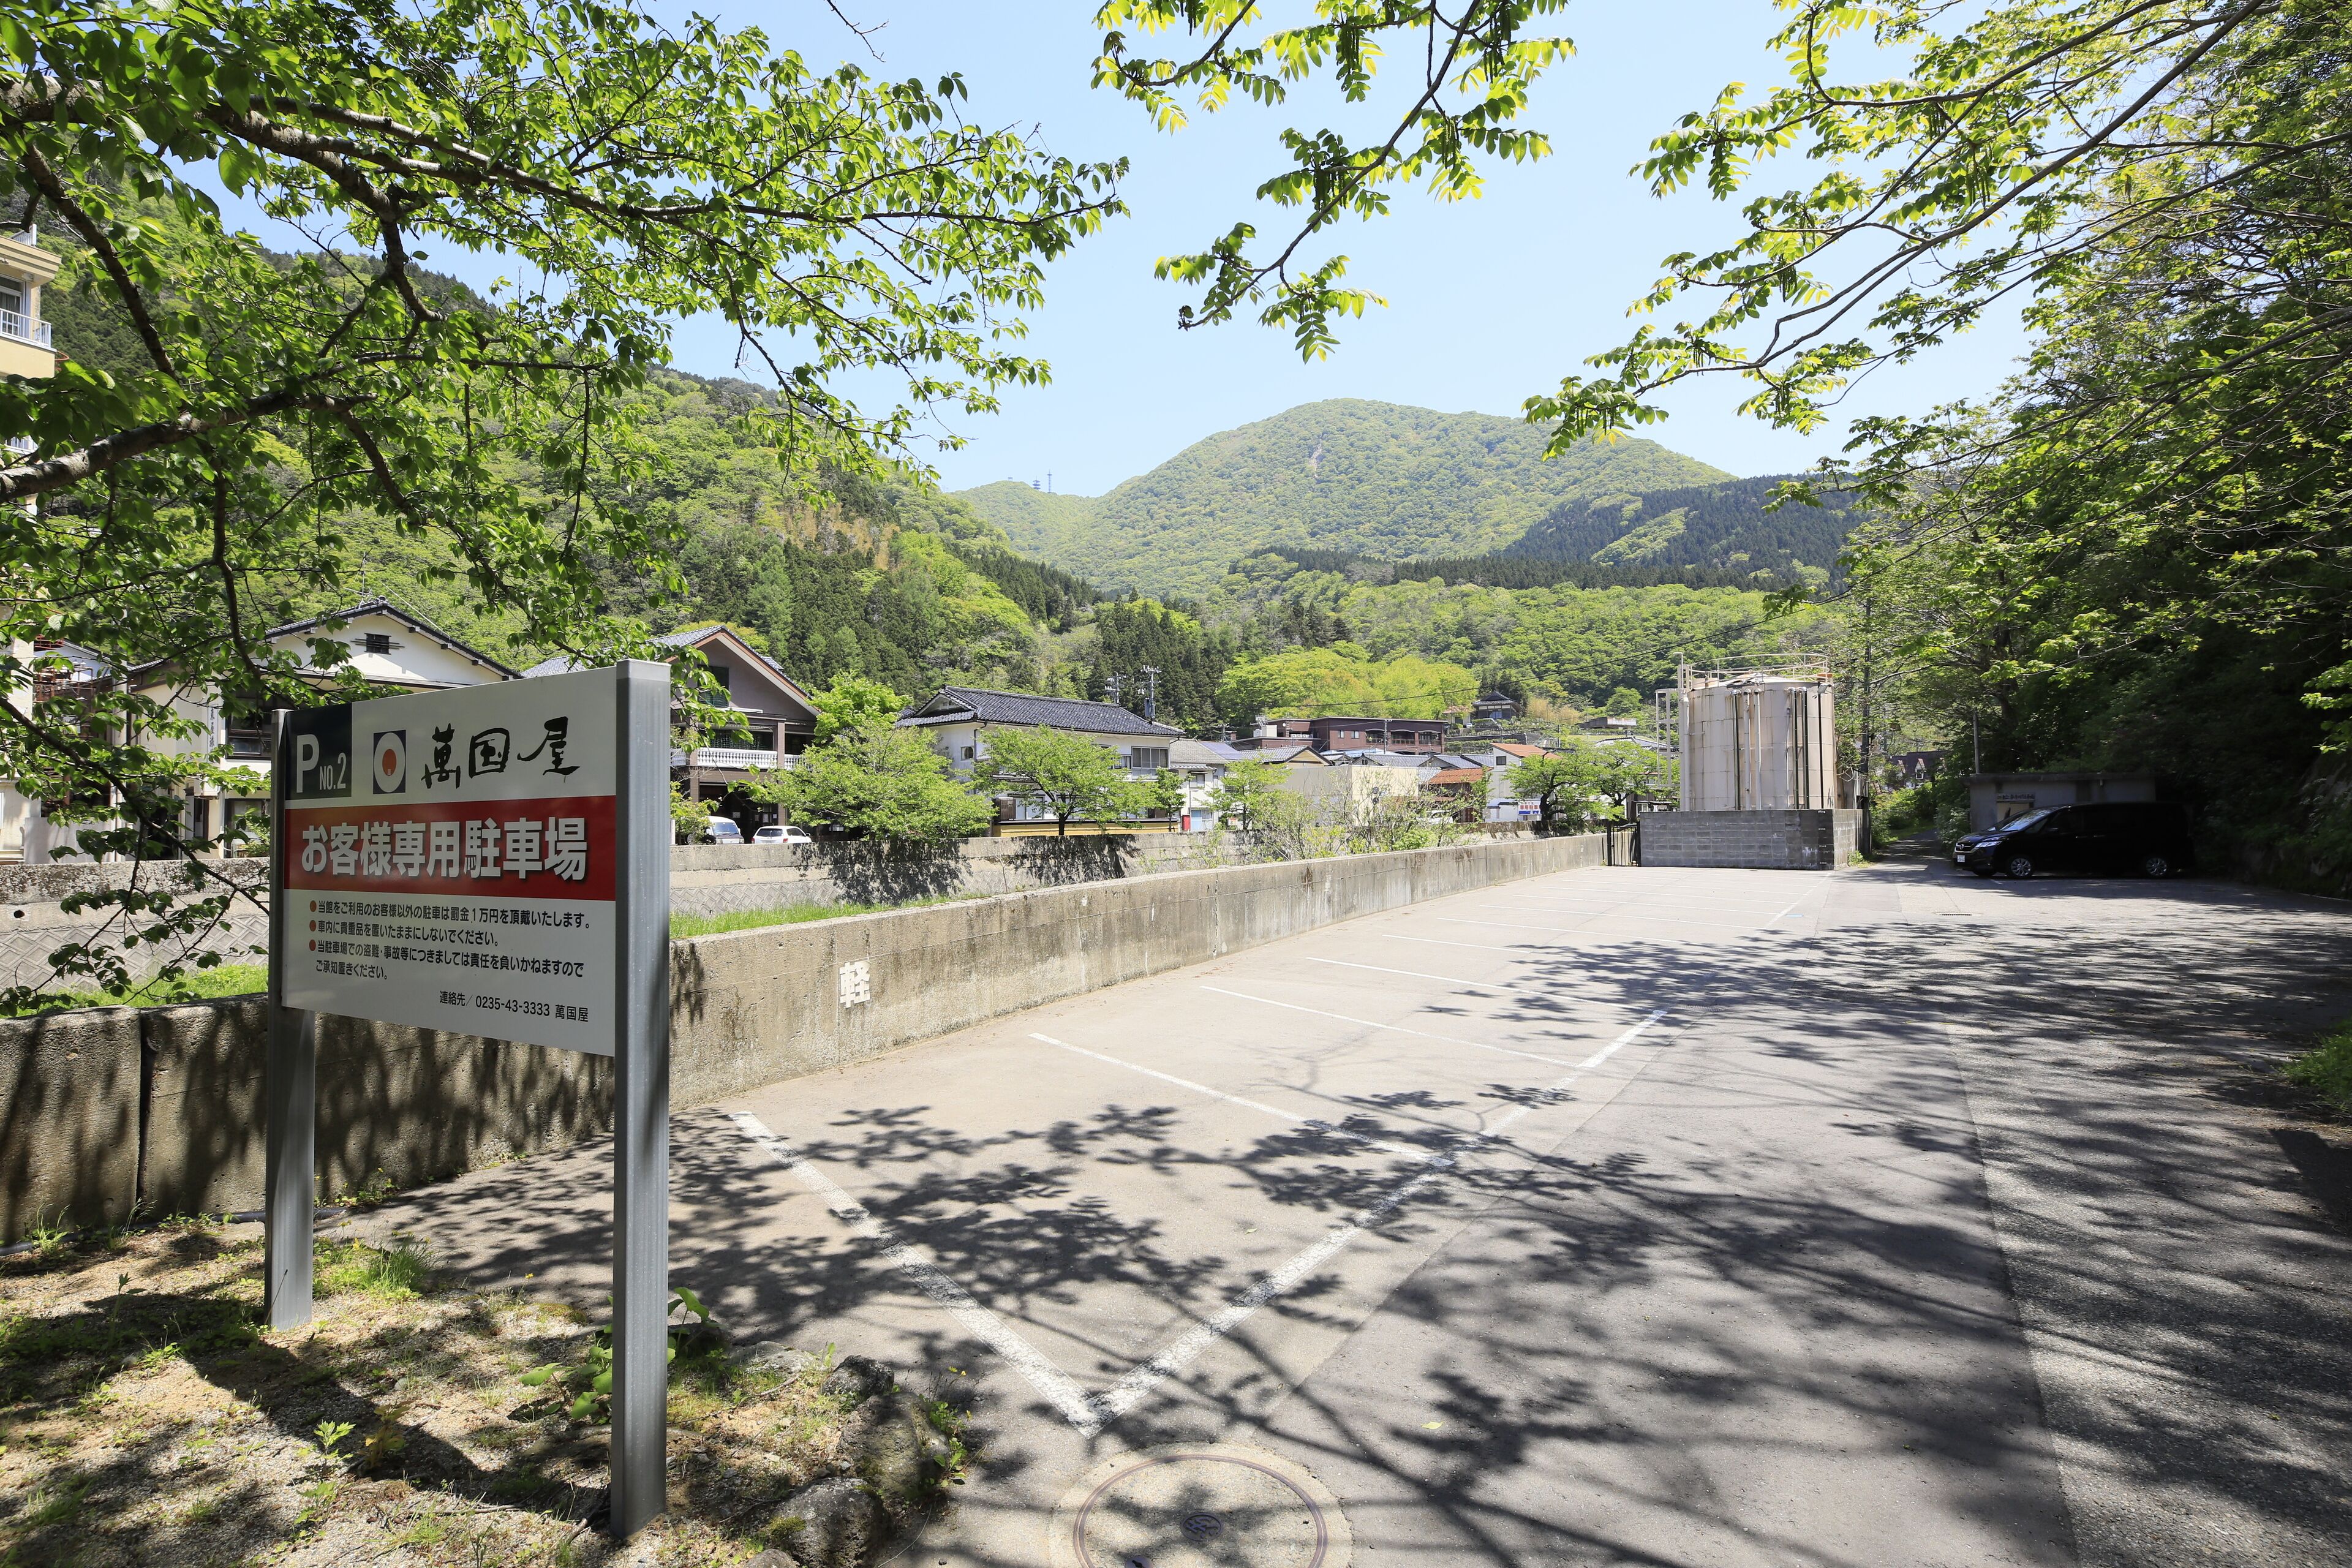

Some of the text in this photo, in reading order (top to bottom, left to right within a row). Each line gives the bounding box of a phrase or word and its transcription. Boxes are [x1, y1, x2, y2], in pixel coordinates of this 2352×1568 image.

[296, 734, 347, 793] P NO.2
[420, 715, 581, 789] 萬国屋
[301, 816, 587, 881] お客様専用駐車場
[318, 920, 498, 946] 車内に貴重品を置いたままにしないでください。
[316, 960, 388, 980] ご承知置きください。
[839, 960, 871, 1008] 軽
[475, 995, 551, 1017] 0235-43-3333
[555, 1004, 589, 1022] 萬国屋
